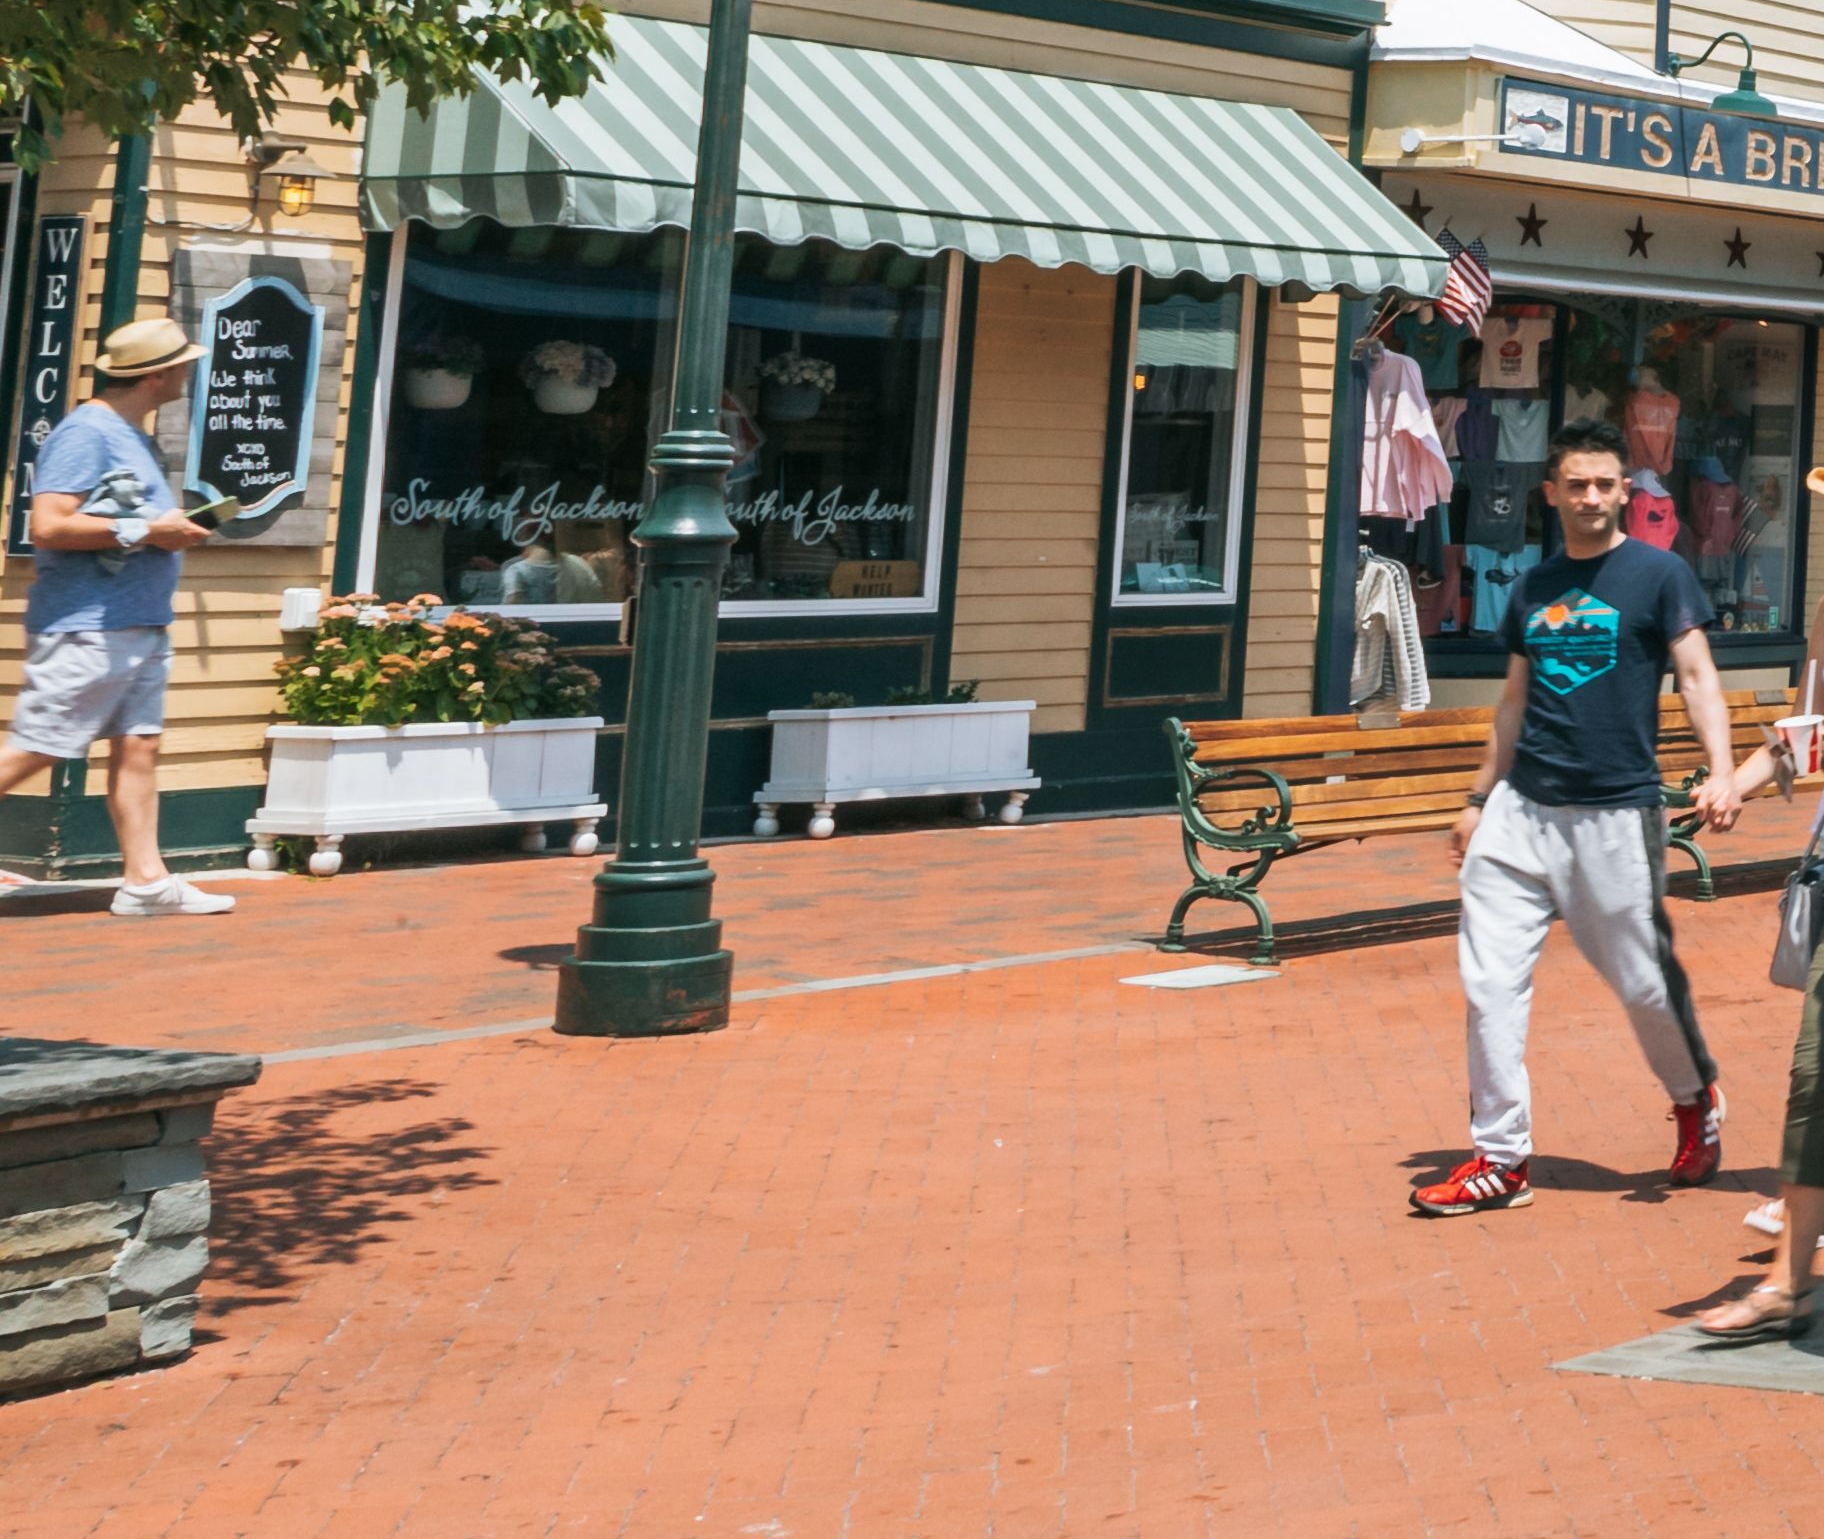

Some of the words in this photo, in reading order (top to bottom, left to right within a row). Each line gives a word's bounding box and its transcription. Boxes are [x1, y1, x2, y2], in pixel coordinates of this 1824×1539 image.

[1573, 101, 1673, 167] IT'S
[1690, 121, 1724, 176] A
[218, 317, 262, 339] Dear
[211, 370, 237, 388] We
[242, 368, 276, 386] think
[210, 390, 251, 409] about
[258, 394, 281, 412] you
[209, 414, 228, 430] all
[231, 414, 253, 430] the
[222, 455, 254, 471] South
[255, 456, 270, 469] of
[241, 470, 291, 487] Jackson
[390, 478, 485, 526] South
[488, 486, 526, 541] of
[511, 481, 645, 546] Jackson
[724, 489, 779, 526] outh
[780, 490, 814, 539] of
[802, 485, 915, 546] Jackson
